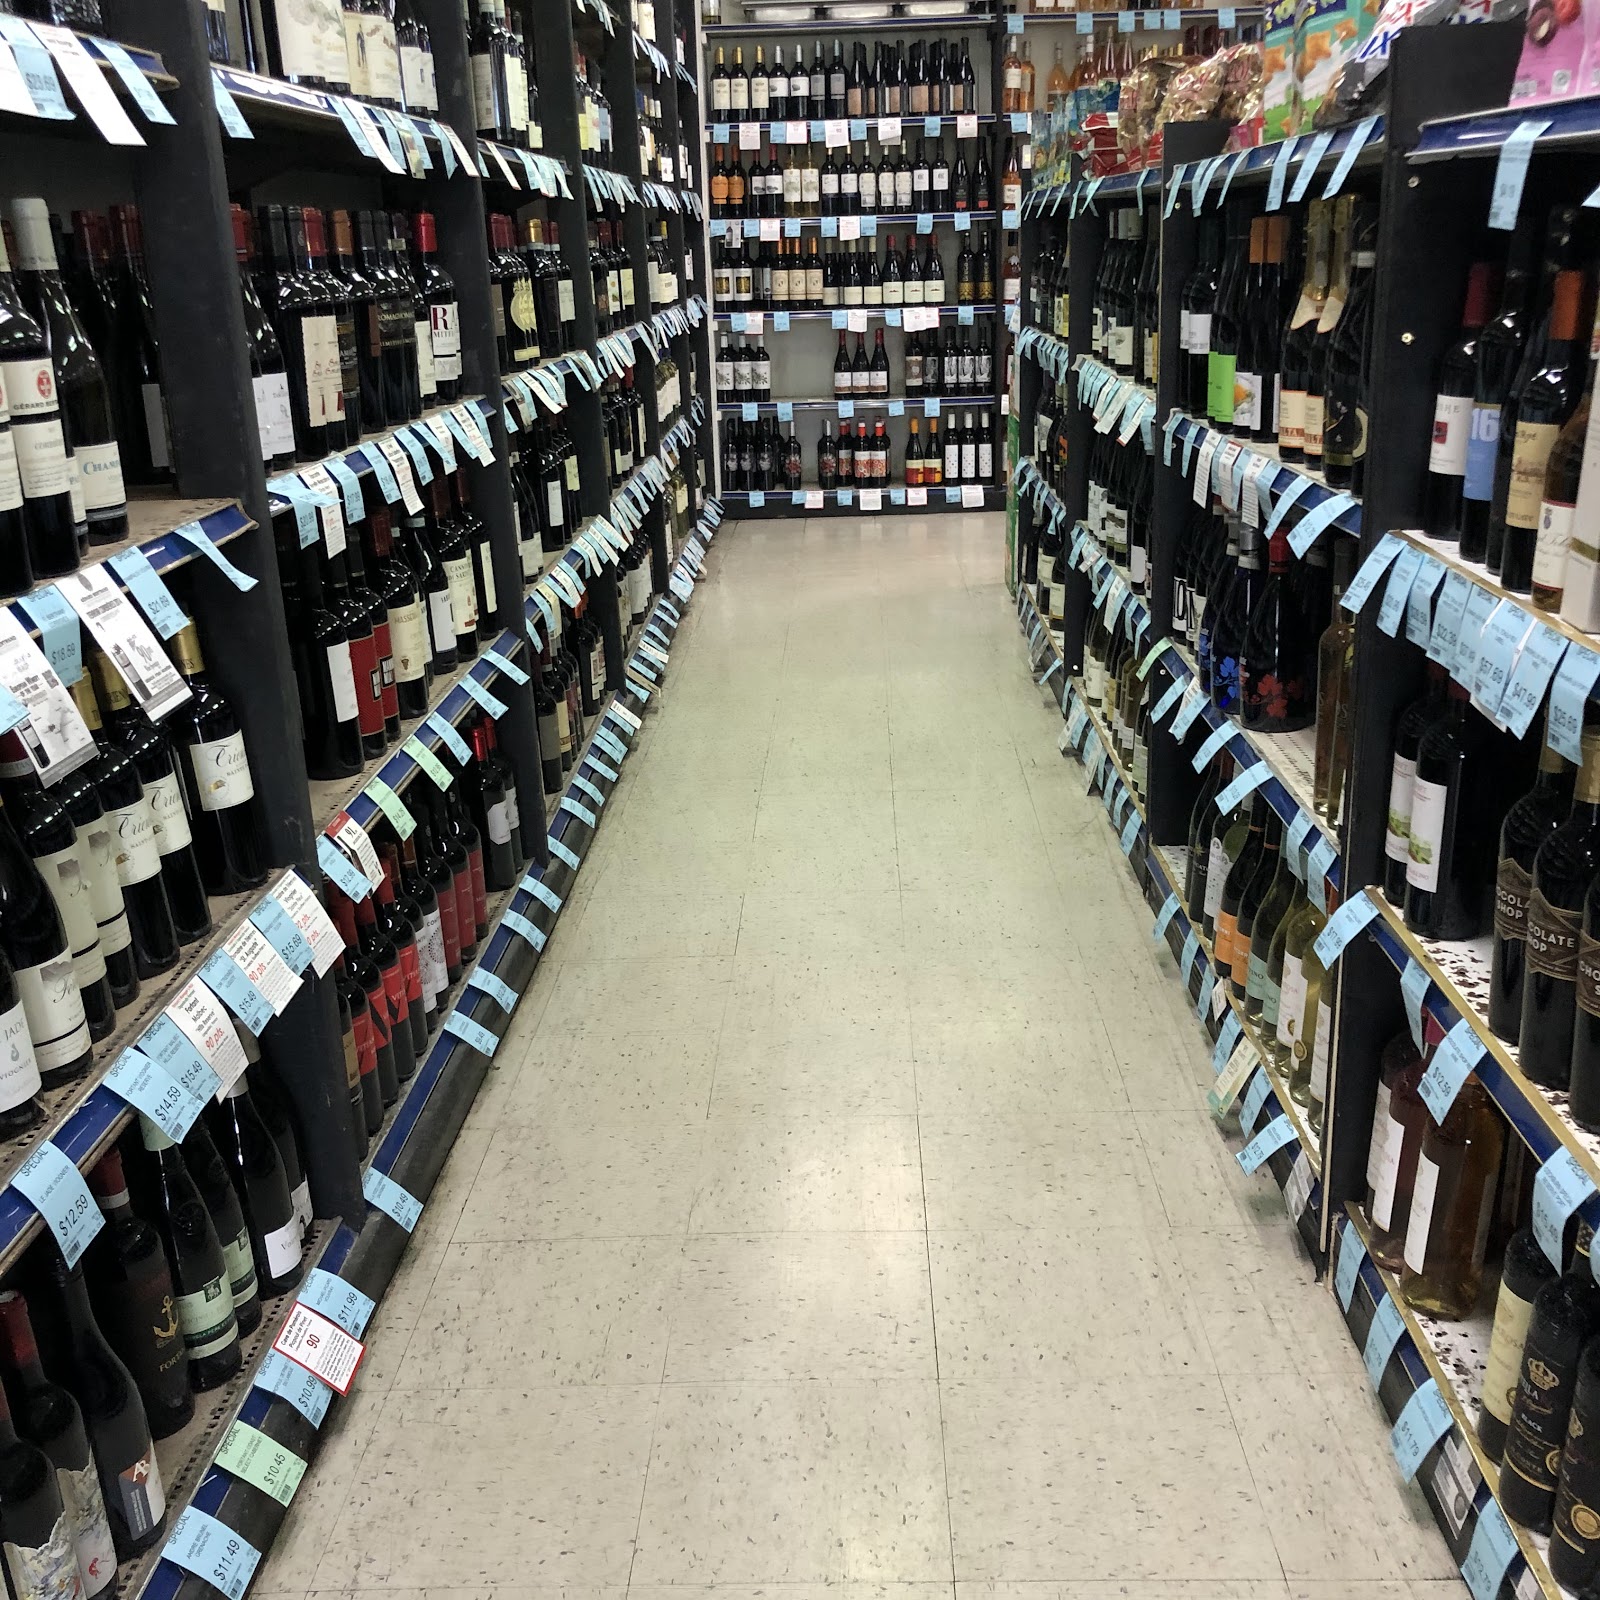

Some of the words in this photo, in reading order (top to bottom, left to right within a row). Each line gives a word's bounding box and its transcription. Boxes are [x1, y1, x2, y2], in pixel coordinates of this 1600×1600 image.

[1471, 408, 1500, 442] 16
[281, 933, 303, 961] $15.69
[203, 952, 223, 974] SPECIAL
[184, 996, 199, 1015] Fortant
[190, 1005, 208, 1025] Malbec
[238, 990, 258, 1016] $15.49
[143, 1017, 167, 1042] SPECIAL
[205, 1037, 216, 1051] 90
[109, 1051, 132, 1078] SPECIAL
[179, 1059, 204, 1089] $15.49
[154, 1085, 183, 1123] $14.59
[20, 1149, 50, 1178] SPECIAL
[58, 1194, 90, 1237] $12.59
[391, 1192, 410, 1218] $10.49
[302, 1273, 318, 1295] SPECIAL
[337, 1291, 359, 1325] $11.99
[306, 1333, 321, 1350] 90
[258, 1351, 276, 1378] SPECIAL
[298, 1375, 319, 1409] $10.99
[221, 1428, 242, 1456] SPECIAL
[263, 1453, 286, 1486] $10.45
[168, 1514, 191, 1546] SPECIAL
[213, 1539, 241, 1582] $11.49
